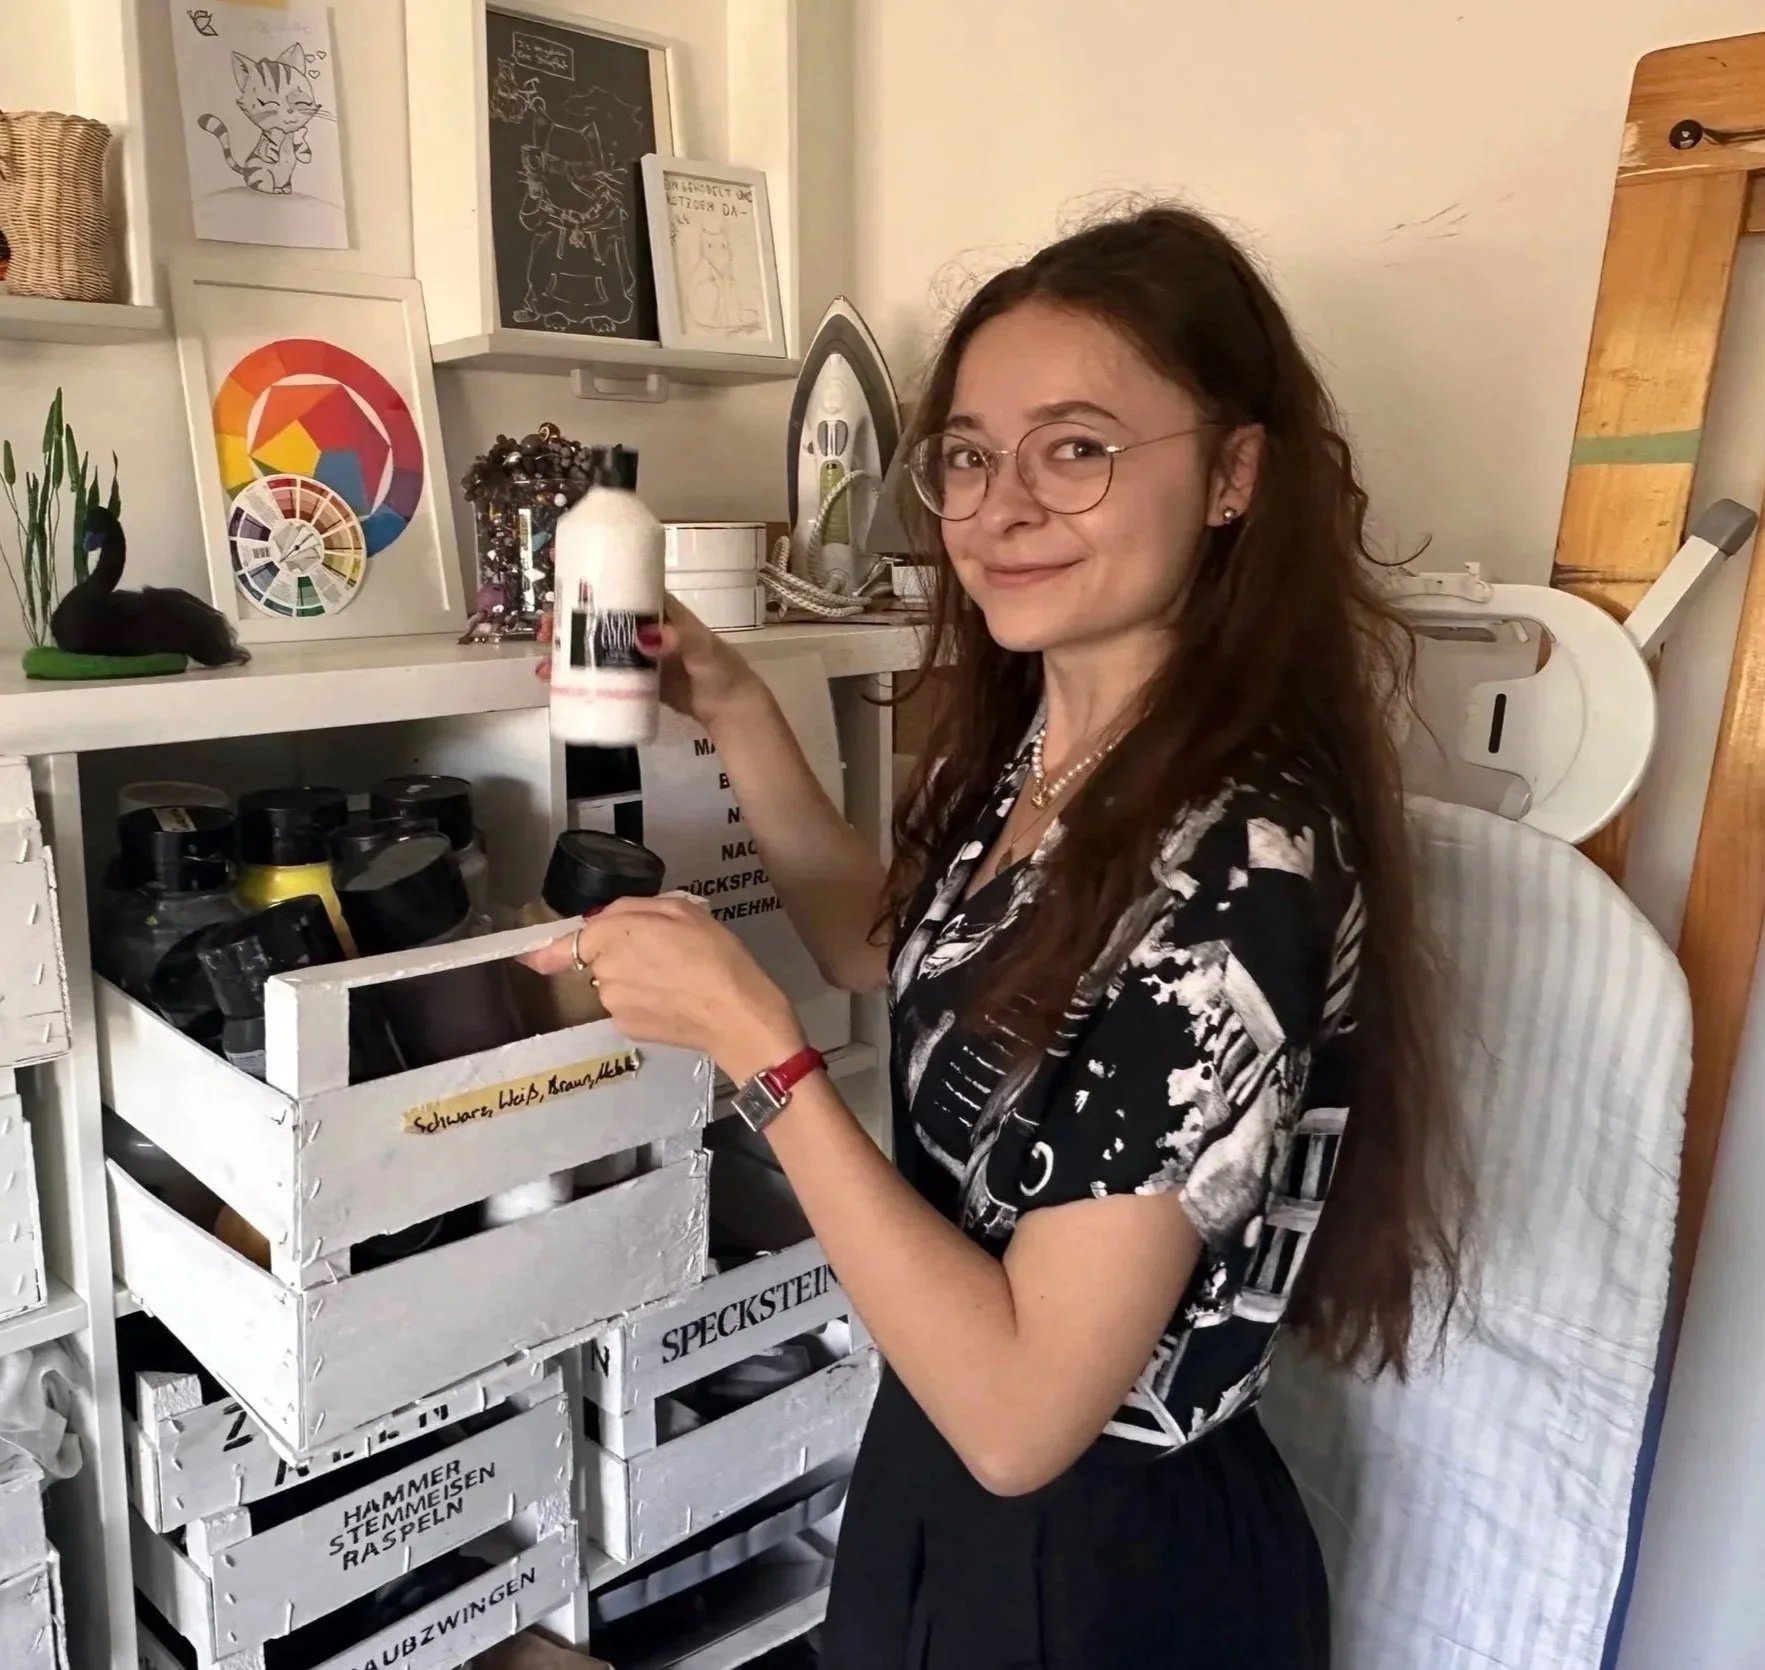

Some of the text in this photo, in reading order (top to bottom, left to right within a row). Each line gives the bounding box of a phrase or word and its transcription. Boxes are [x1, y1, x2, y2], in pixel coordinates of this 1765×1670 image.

[721, 839, 758, 861] NAC
[329, 1462, 496, 1556] STEMMEISEN
[344, 1459, 460, 1528] HAMMER
[342, 1499, 463, 1571] RASPELN
[351, 1567, 535, 1670] AUBZWINGEN
